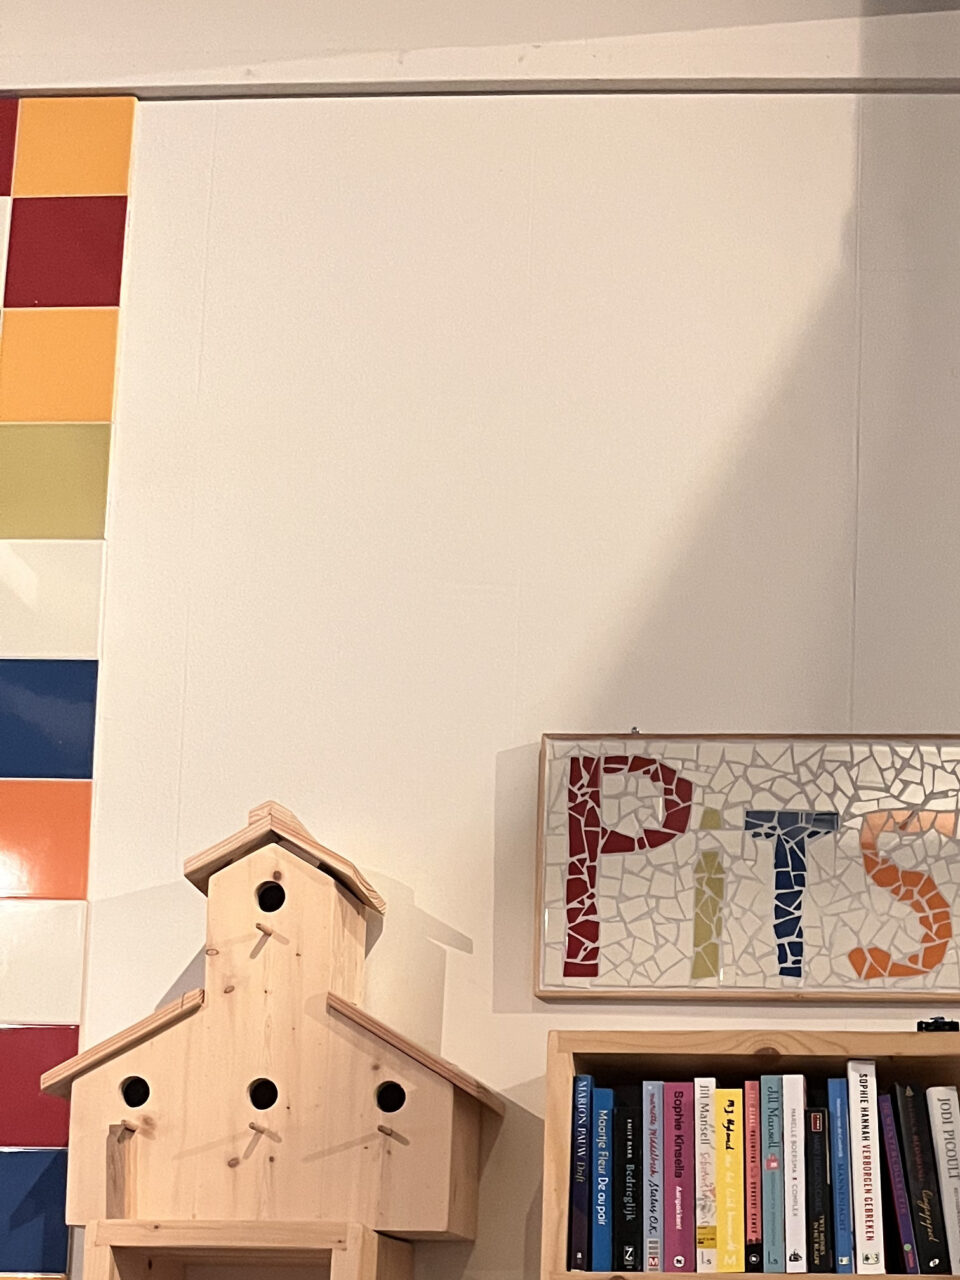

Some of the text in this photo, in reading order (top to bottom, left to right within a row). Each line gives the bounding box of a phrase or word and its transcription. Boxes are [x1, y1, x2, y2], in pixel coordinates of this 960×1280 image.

[672, 1091, 684, 1130] Sophie
[699, 1084, 709, 1098] Jill
[938, 1097, 955, 1125] JODI
[576, 1081, 587, 1183] MARION PAUW Drift
[700, 1103, 710, 1145] Mansell
[722, 1119, 735, 1150] Hyland
[767, 1086, 779, 1149] Jill Mansell
[596, 1110, 609, 1225] Maartje Fleur De au pair
[674, 1135, 684, 1178] Kinsella
[859, 1074, 875, 1241] SOPHIE HANNAH VERBORGEN GEBREKEN
[942, 1129, 960, 1182] PICOULT
[623, 1164, 635, 1221] Bedrieglijk
[648, 1180, 658, 1213] Status
[837, 1163, 846, 1232] MANNENJACHT
